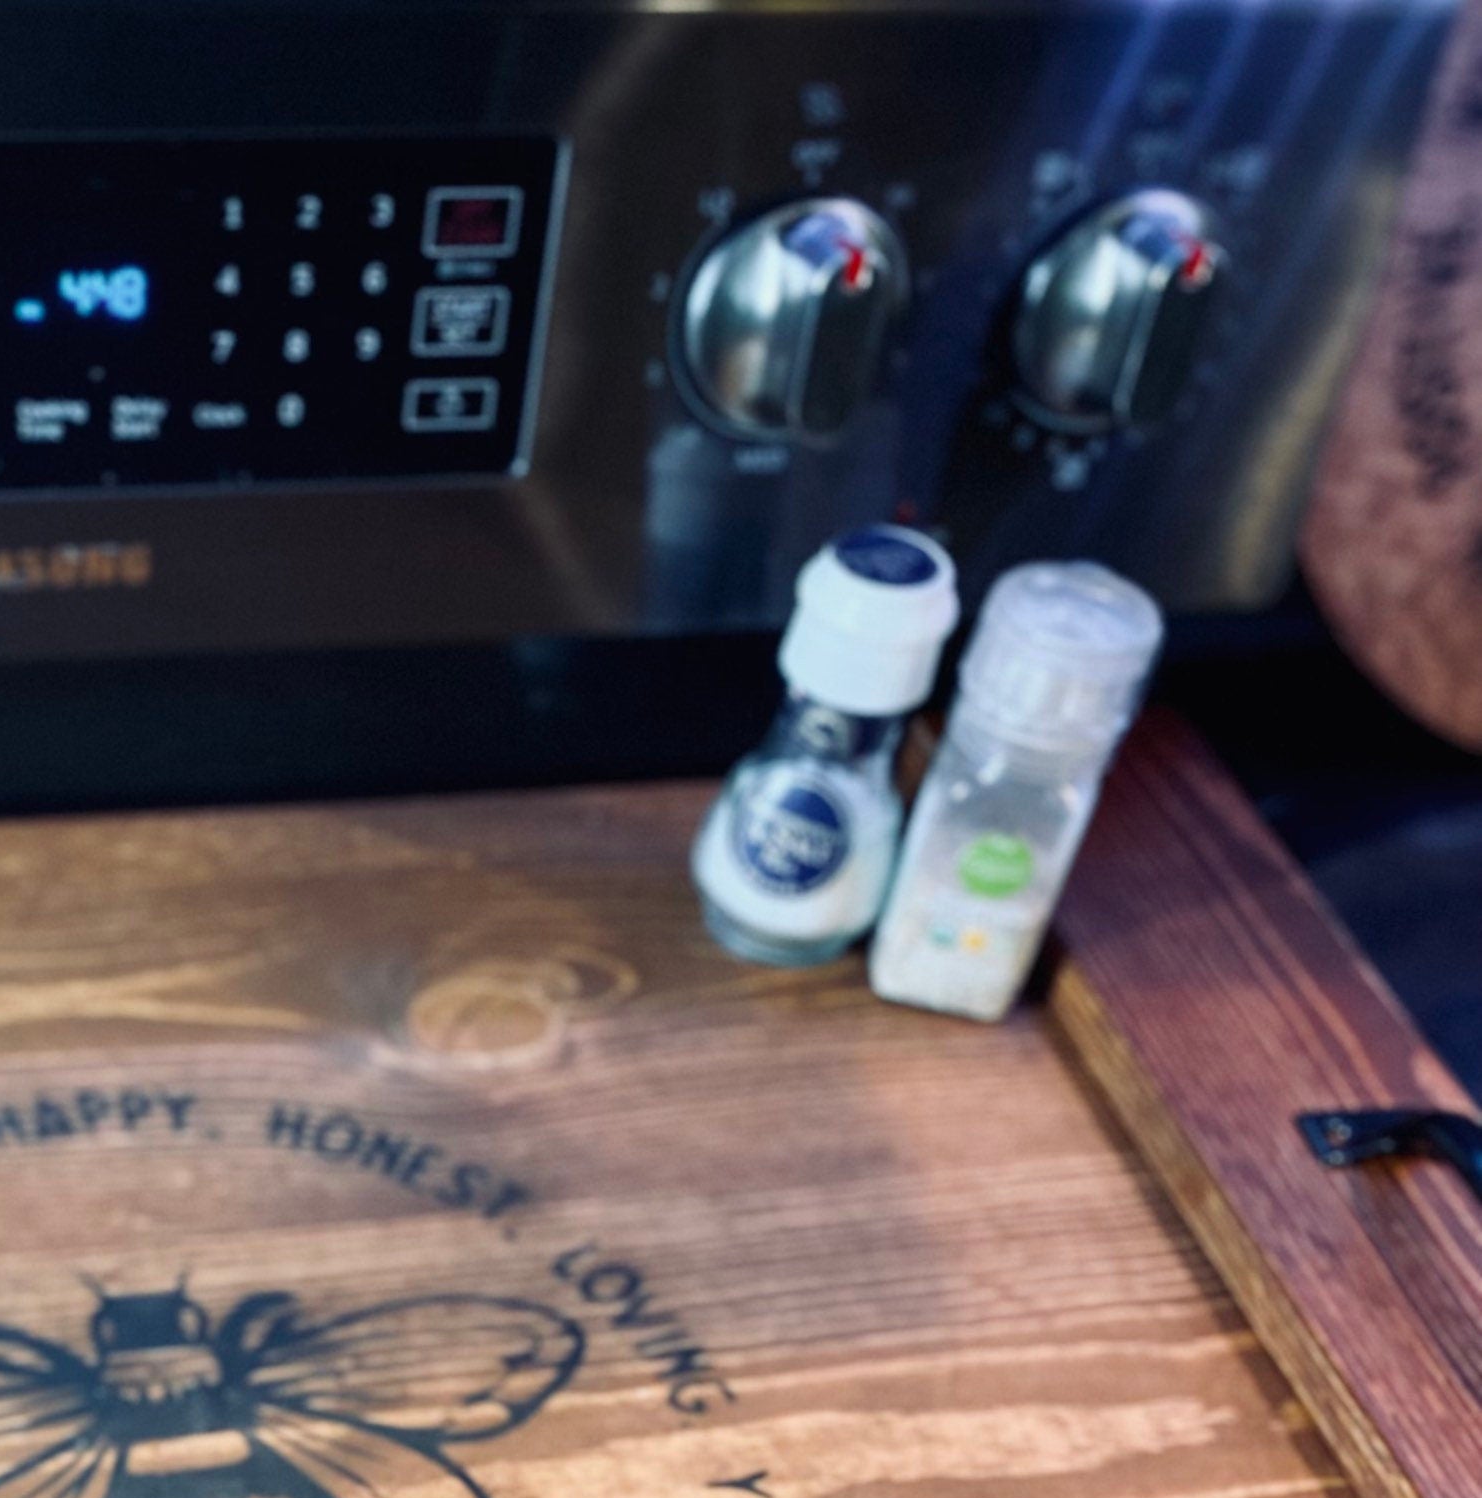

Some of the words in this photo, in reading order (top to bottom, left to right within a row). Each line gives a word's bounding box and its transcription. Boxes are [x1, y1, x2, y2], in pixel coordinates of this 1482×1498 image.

[223, 195, 245, 231] 1
[295, 193, 323, 230] 2
[369, 192, 396, 229] 3
[214, 262, 241, 297] 4
[210, 328, 238, 365] 7
